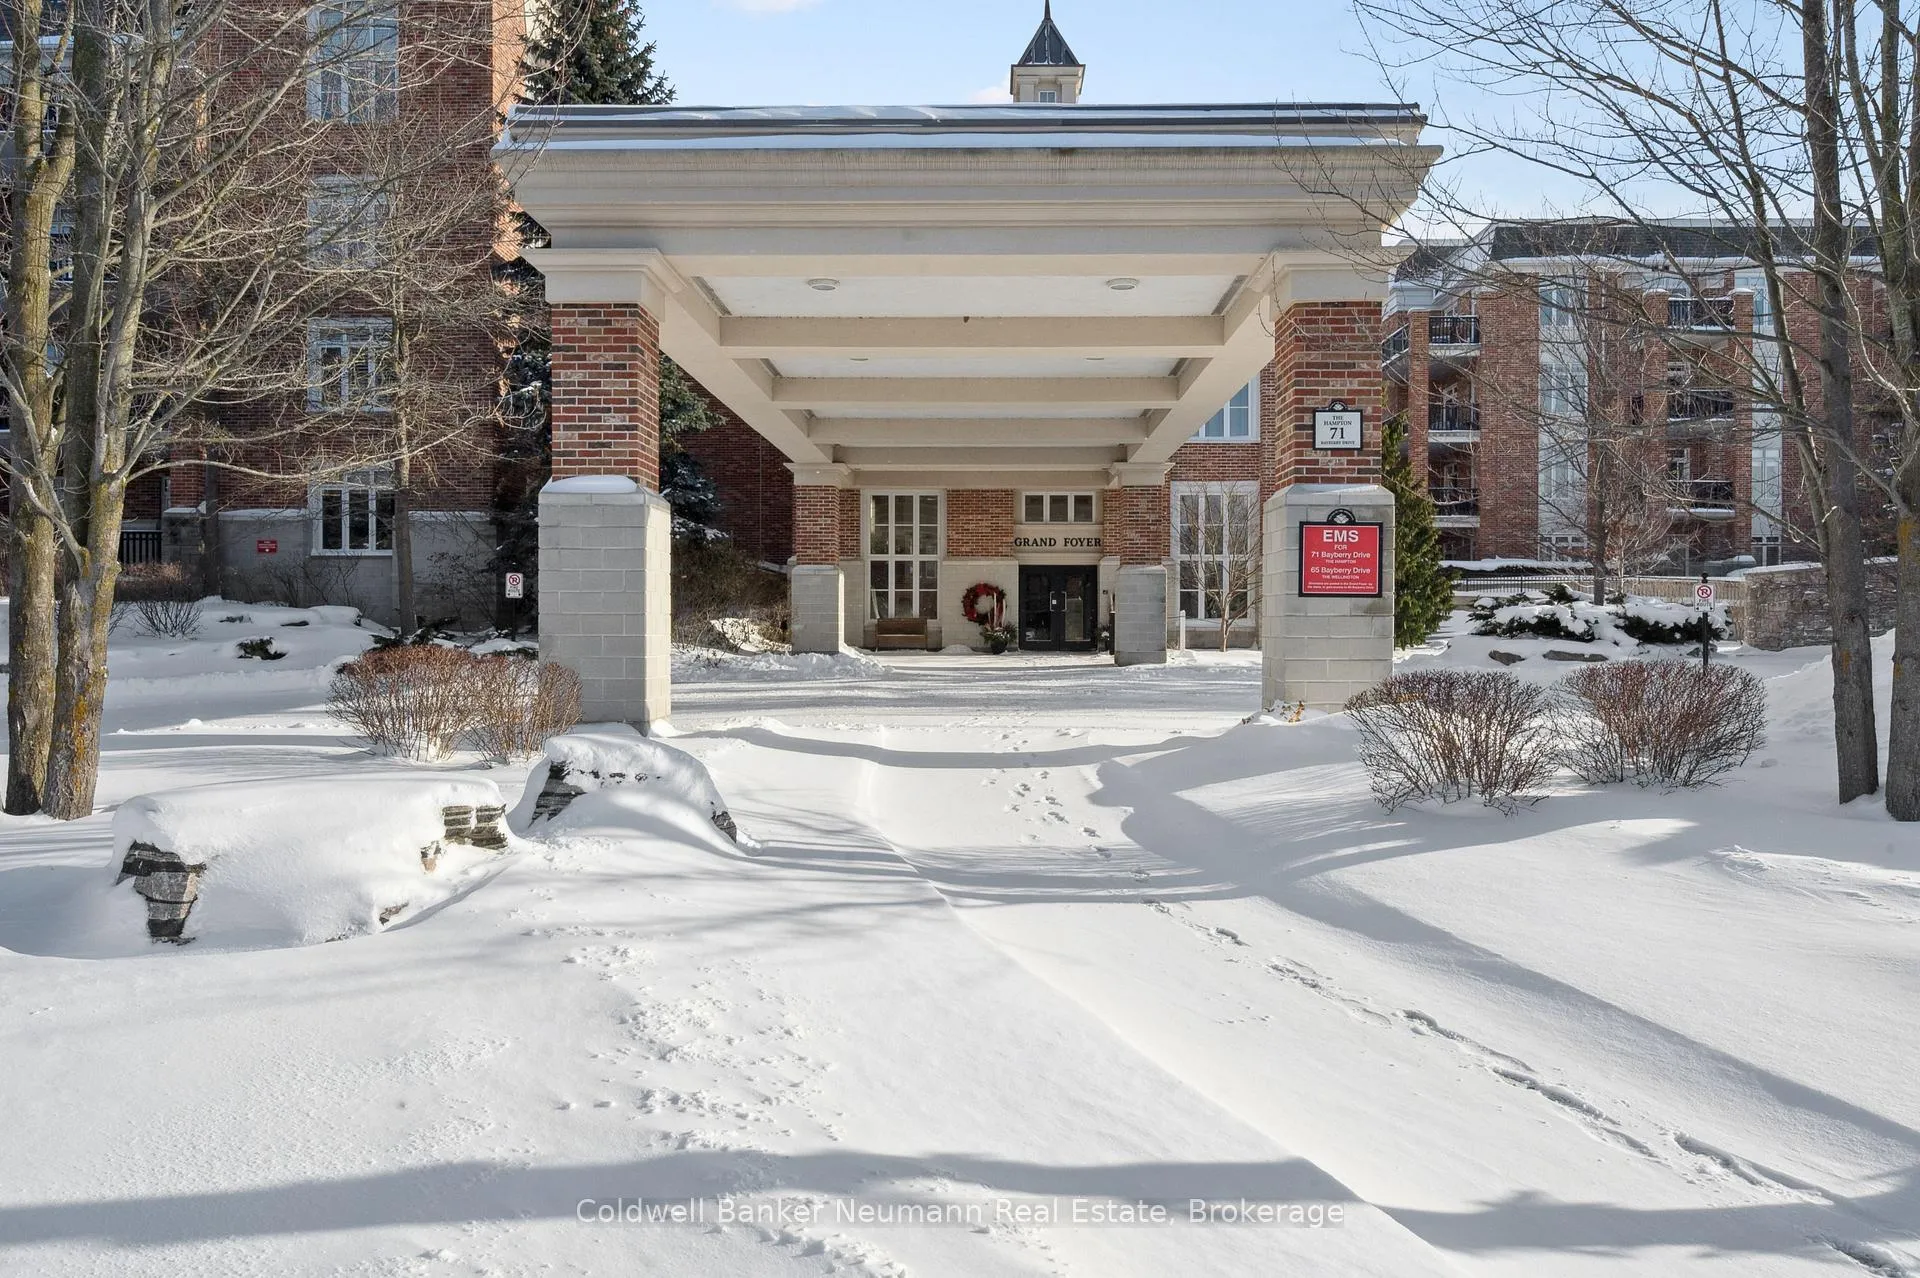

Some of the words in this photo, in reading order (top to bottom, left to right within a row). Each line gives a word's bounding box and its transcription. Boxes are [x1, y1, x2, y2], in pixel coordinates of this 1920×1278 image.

[1329, 427, 1345, 440] 71
[1323, 529, 1359, 542] EMS
[1014, 537, 1057, 547] GRAND
[1063, 537, 1102, 547] FOYER
[1321, 551, 1352, 559] Bayberry
[1321, 566, 1352, 574] Bayberry
